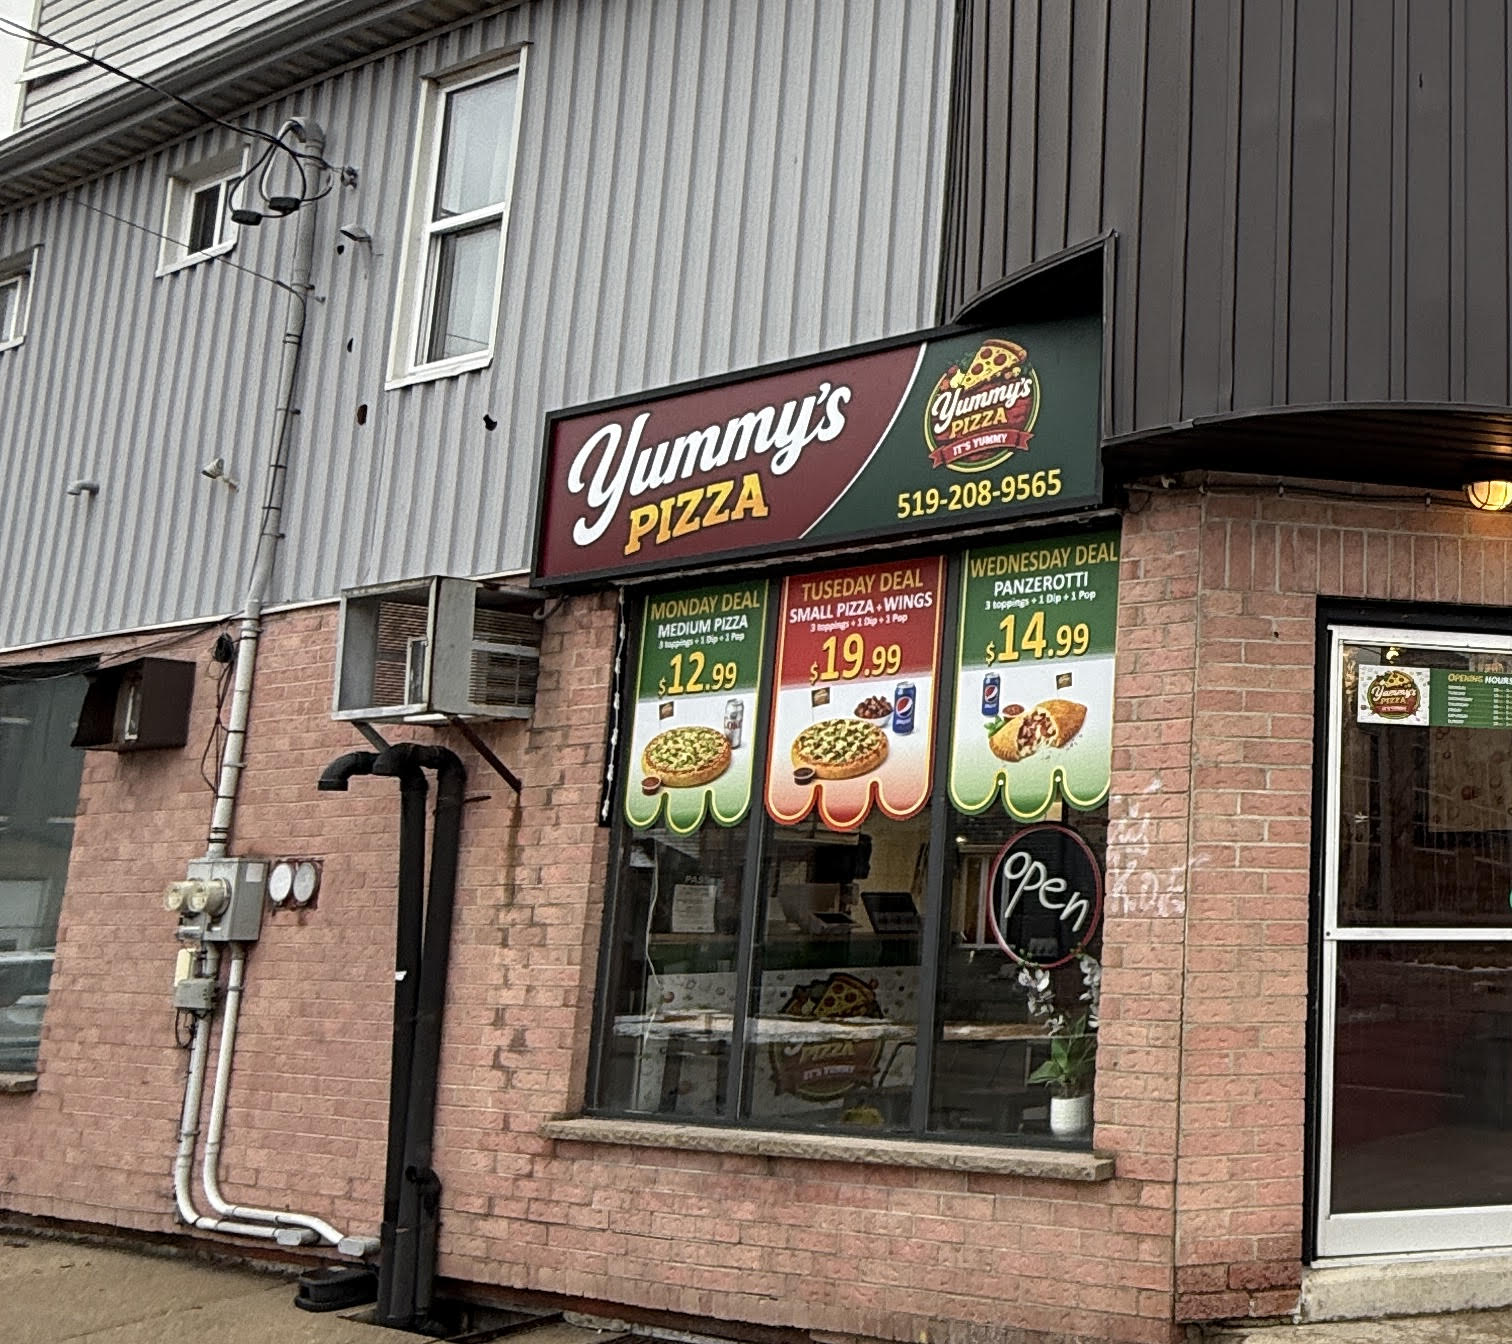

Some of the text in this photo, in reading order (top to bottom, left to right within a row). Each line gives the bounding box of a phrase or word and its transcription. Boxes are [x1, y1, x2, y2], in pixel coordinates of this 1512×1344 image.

[931, 377, 1033, 434] Yummy's
[949, 407, 1008, 439] PIZZA
[952, 432, 1008, 457] IT'S YUMMY
[567, 382, 851, 546] Yummy's
[896, 468, 1062, 519] 519-208-9565
[624, 473, 768, 555] PIZZA
[970, 541, 1118, 578] WEDNESDAY DEAL
[802, 568, 924, 602] TUSEDAY DEAL
[993, 571, 1089, 597] PANZEROTTI
[1078, 590, 1096, 601] Pop
[650, 590, 760, 621] MONDAY DEAL
[789, 607, 834, 624] SMALL
[836, 599, 875, 617] PIZZA
[883, 591, 934, 612] WINGS
[657, 615, 748, 639] MEDIUM PIZZA
[985, 611, 1090, 667] $14.99
[657, 651, 737, 696] $12.99
[809, 632, 902, 686] $19.99
